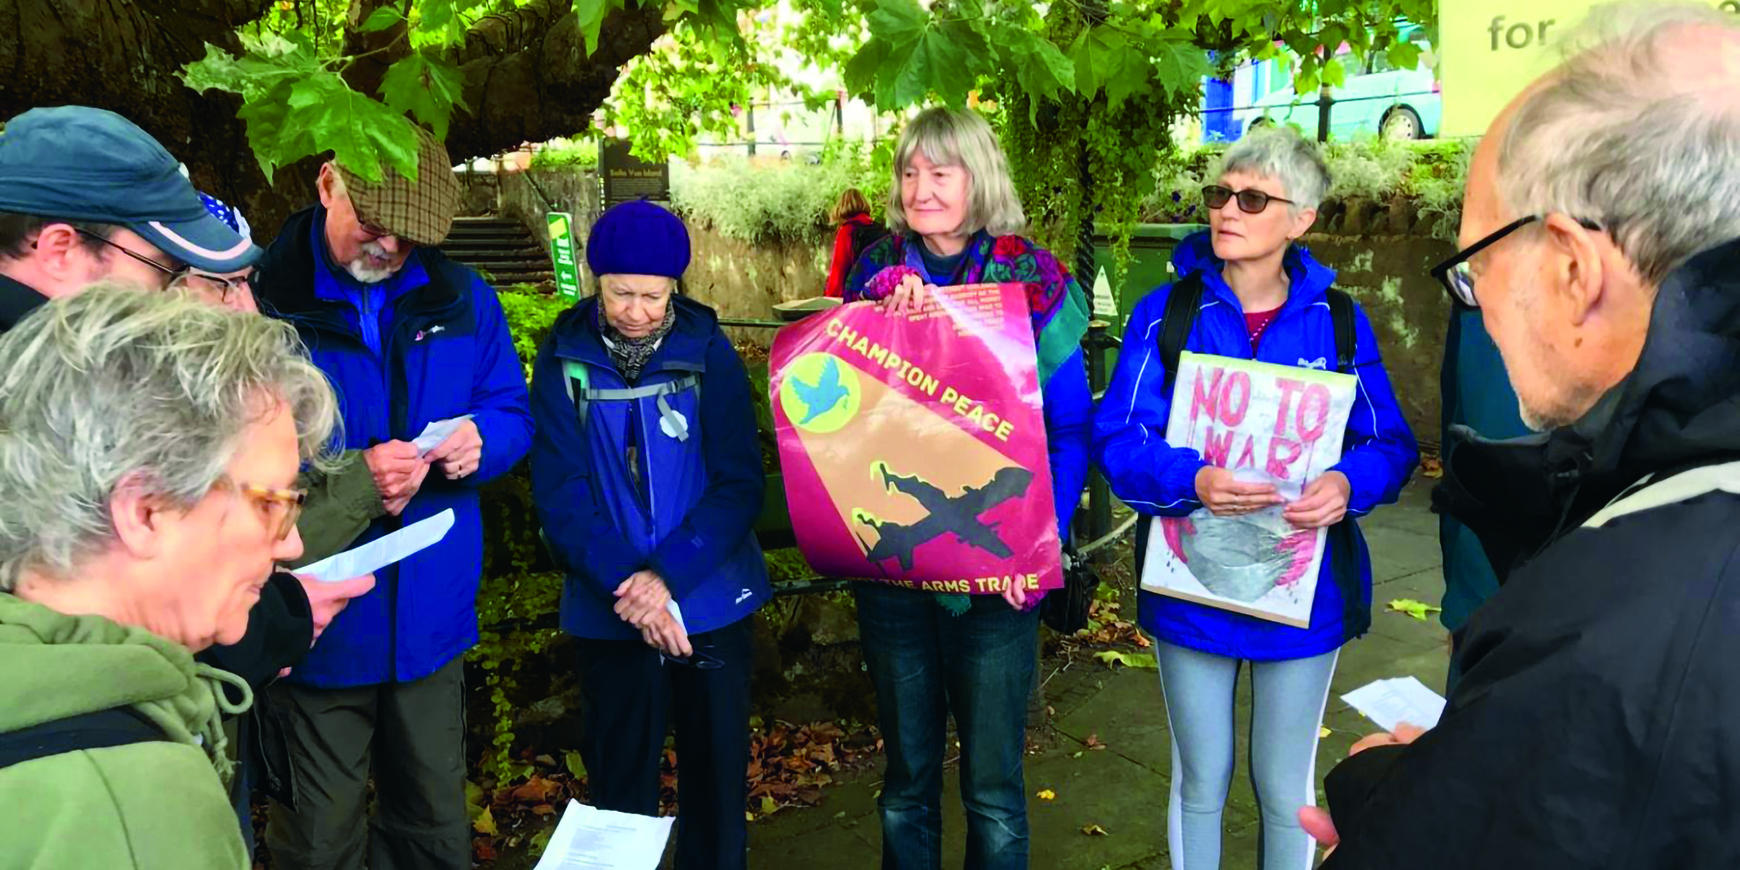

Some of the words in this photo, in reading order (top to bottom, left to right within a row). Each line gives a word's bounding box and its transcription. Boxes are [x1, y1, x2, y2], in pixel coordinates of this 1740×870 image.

[1487, 15, 1556, 52] for
[826, 317, 939, 396] CHAMPION
[940, 386, 1014, 442] PEACE
[1190, 365, 1251, 427] NO
[1274, 377, 1331, 442] TO
[1204, 426, 1302, 480] WAR
[922, 580, 970, 593] ARMS
